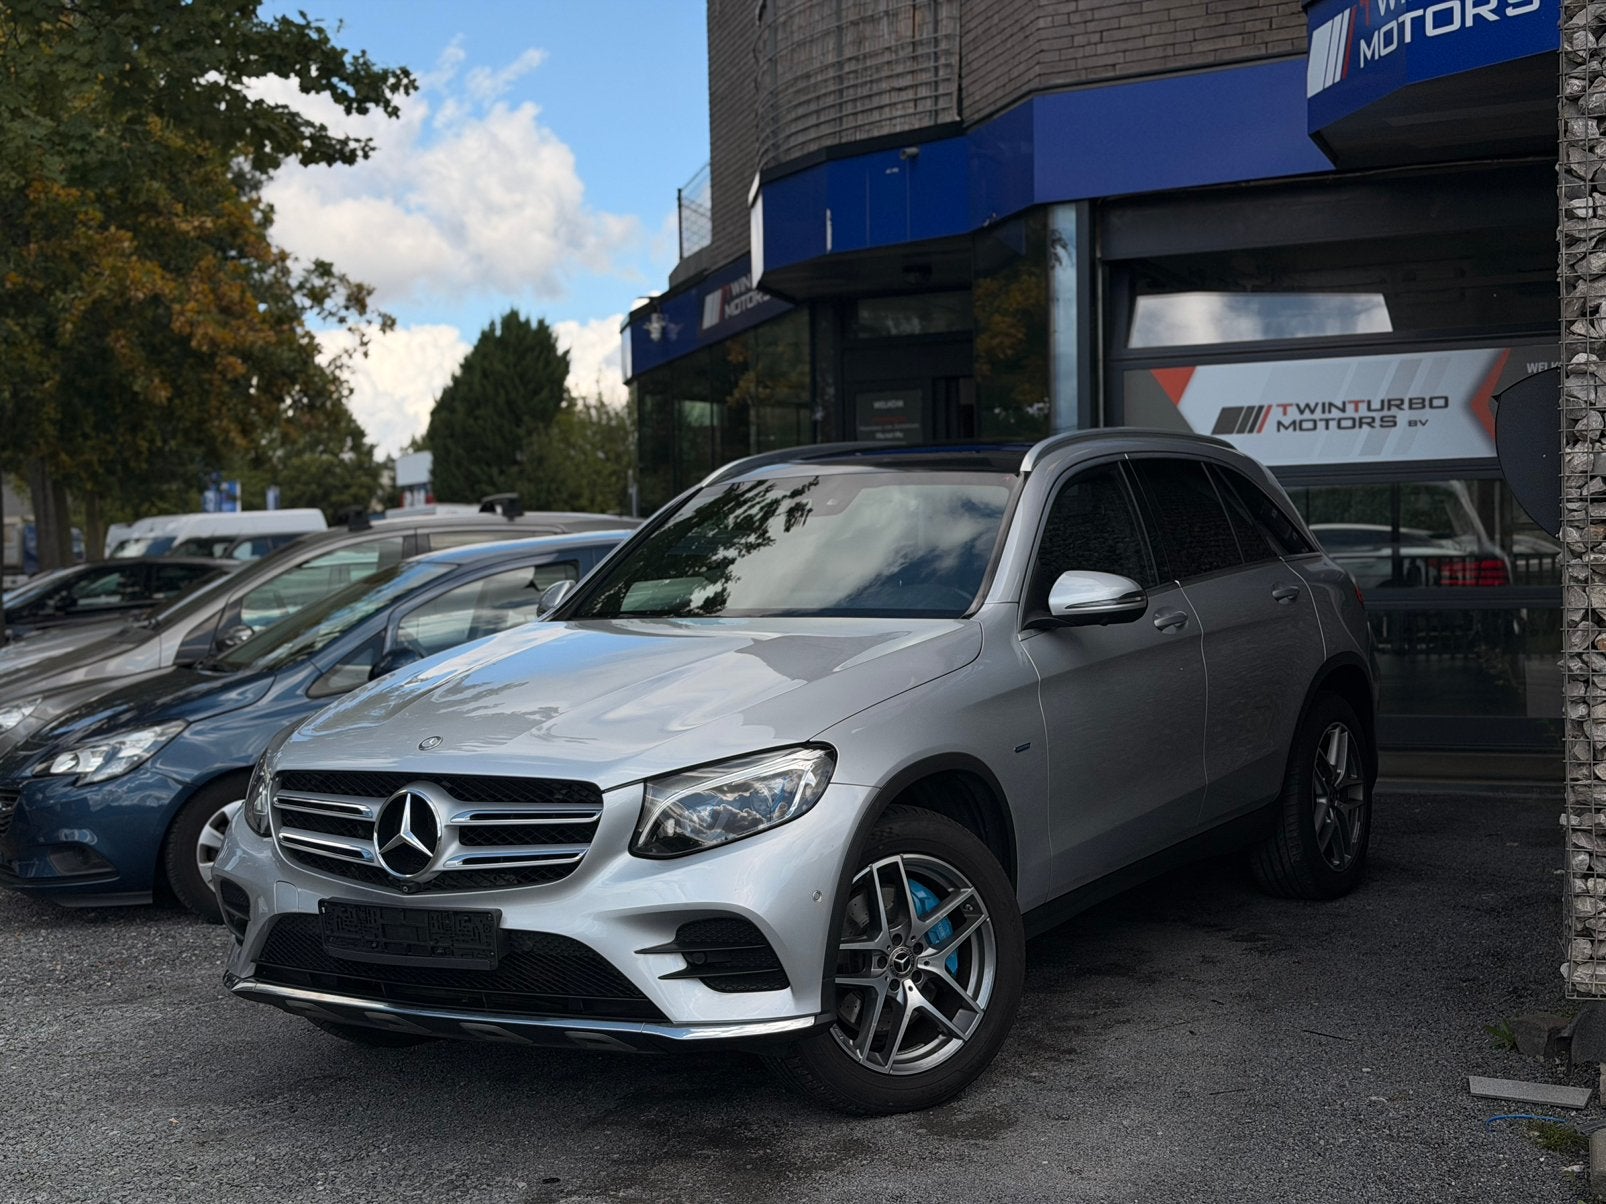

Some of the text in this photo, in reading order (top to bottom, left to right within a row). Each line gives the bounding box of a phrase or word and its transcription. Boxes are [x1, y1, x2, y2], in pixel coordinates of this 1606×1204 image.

[1277, 396, 1449, 416] TWINTURBO
[1277, 415, 1429, 433] MOTORS BV
